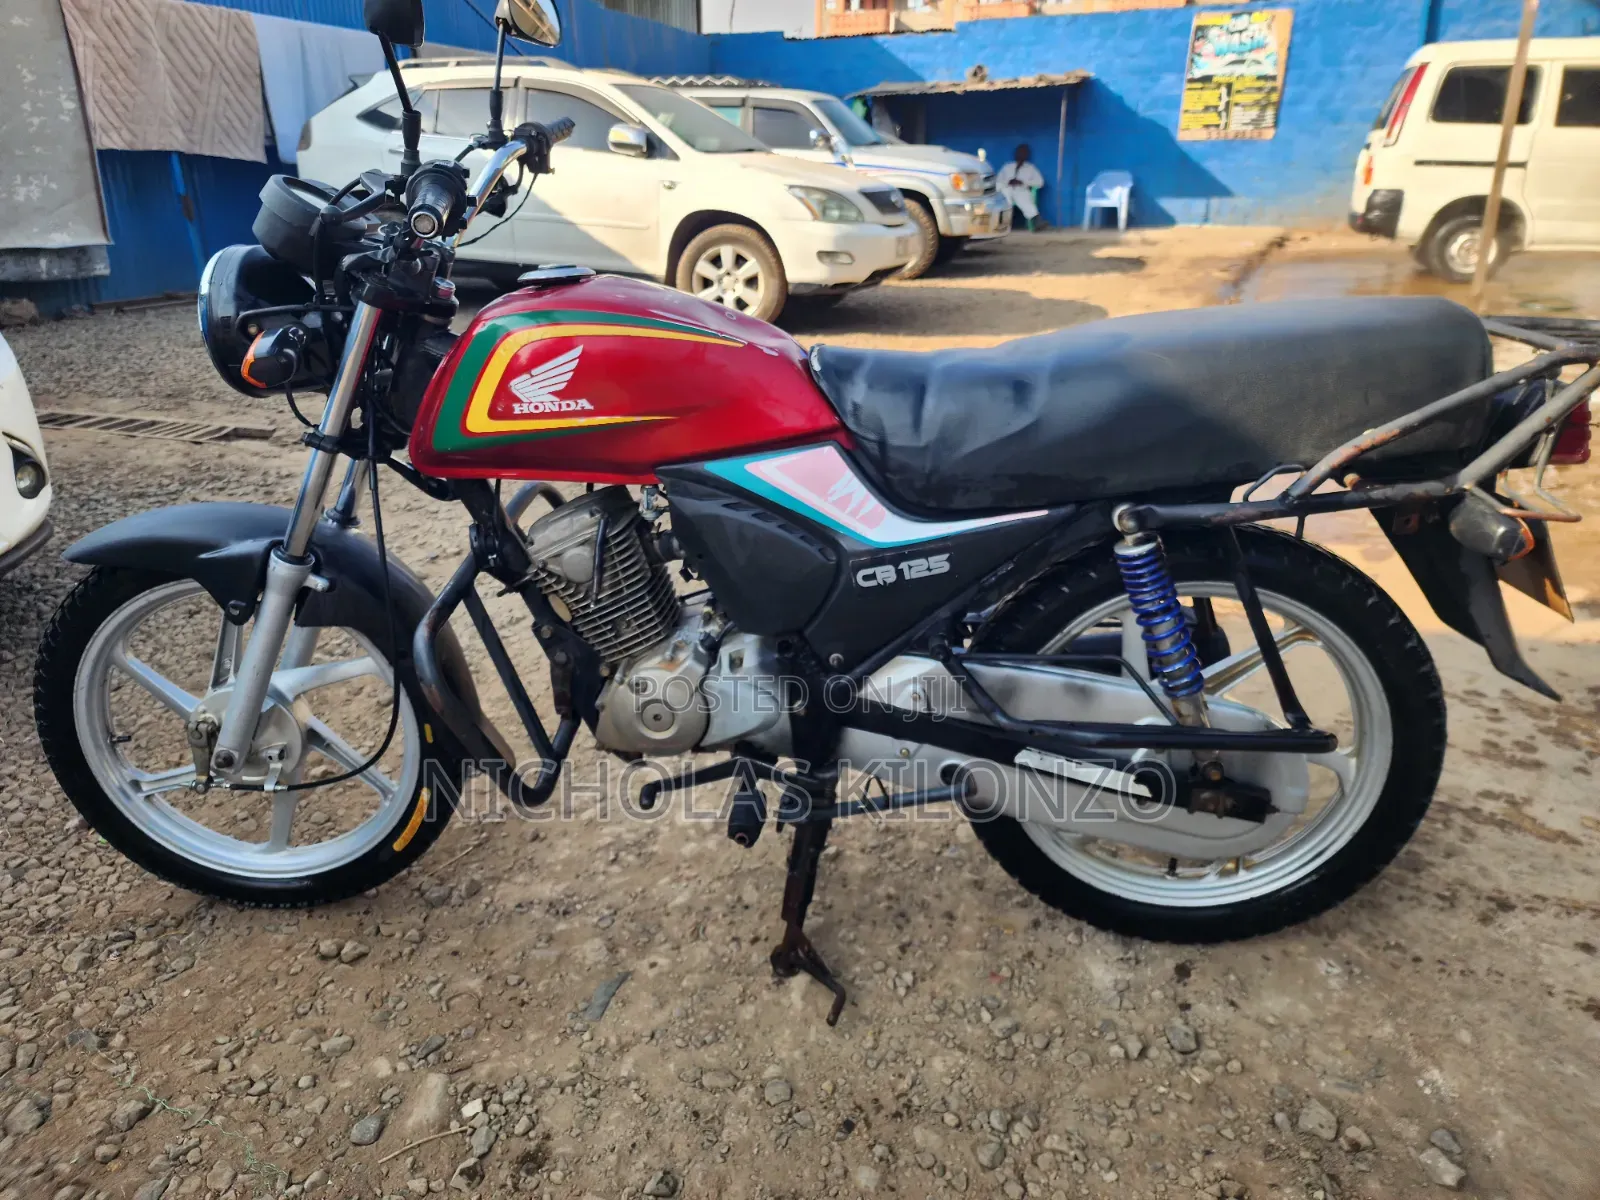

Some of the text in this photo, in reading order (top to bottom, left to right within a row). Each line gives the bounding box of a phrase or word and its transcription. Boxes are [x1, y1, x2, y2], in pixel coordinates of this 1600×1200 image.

[512, 398, 594, 414] HONDA
[856, 553, 951, 588] CB 125
